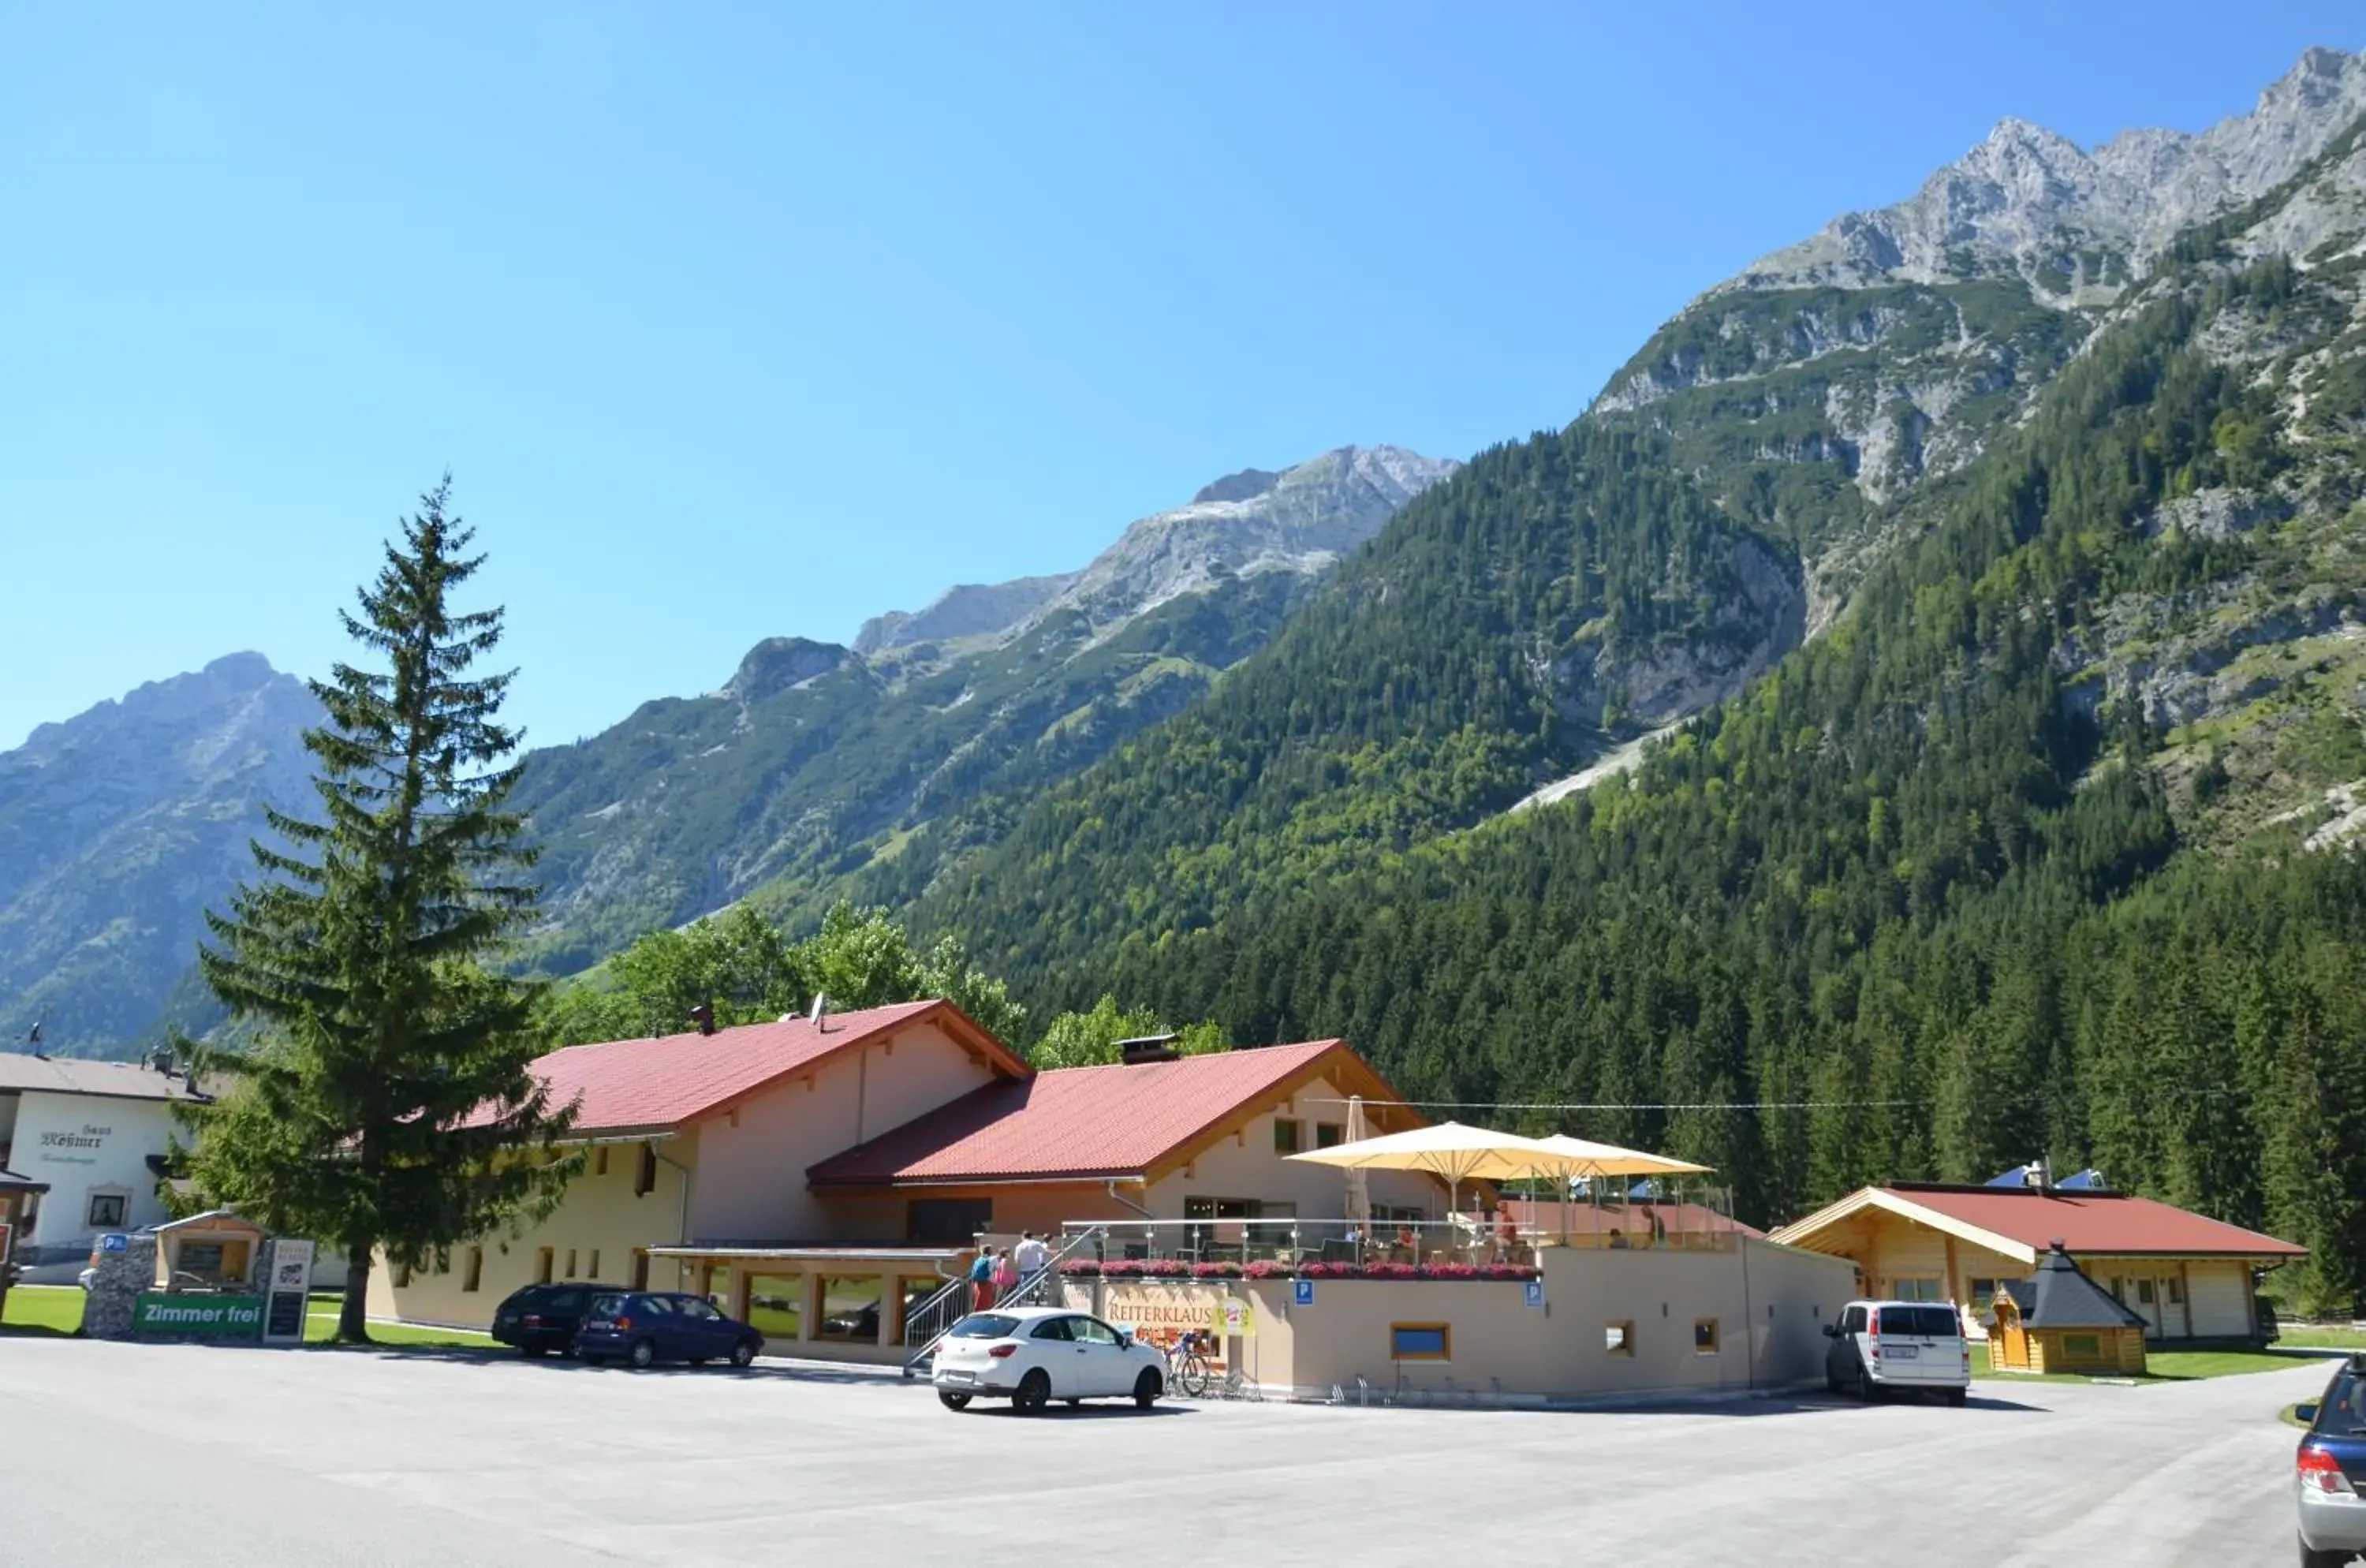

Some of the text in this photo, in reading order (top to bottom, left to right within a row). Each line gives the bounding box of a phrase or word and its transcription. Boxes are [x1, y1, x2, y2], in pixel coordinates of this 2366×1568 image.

[1300, 1283, 1308, 1296] P
[145, 1304, 224, 1322] Zimmer
[227, 1306, 261, 1322] frei
[1109, 1301, 1212, 1324] REITERKLAUS
